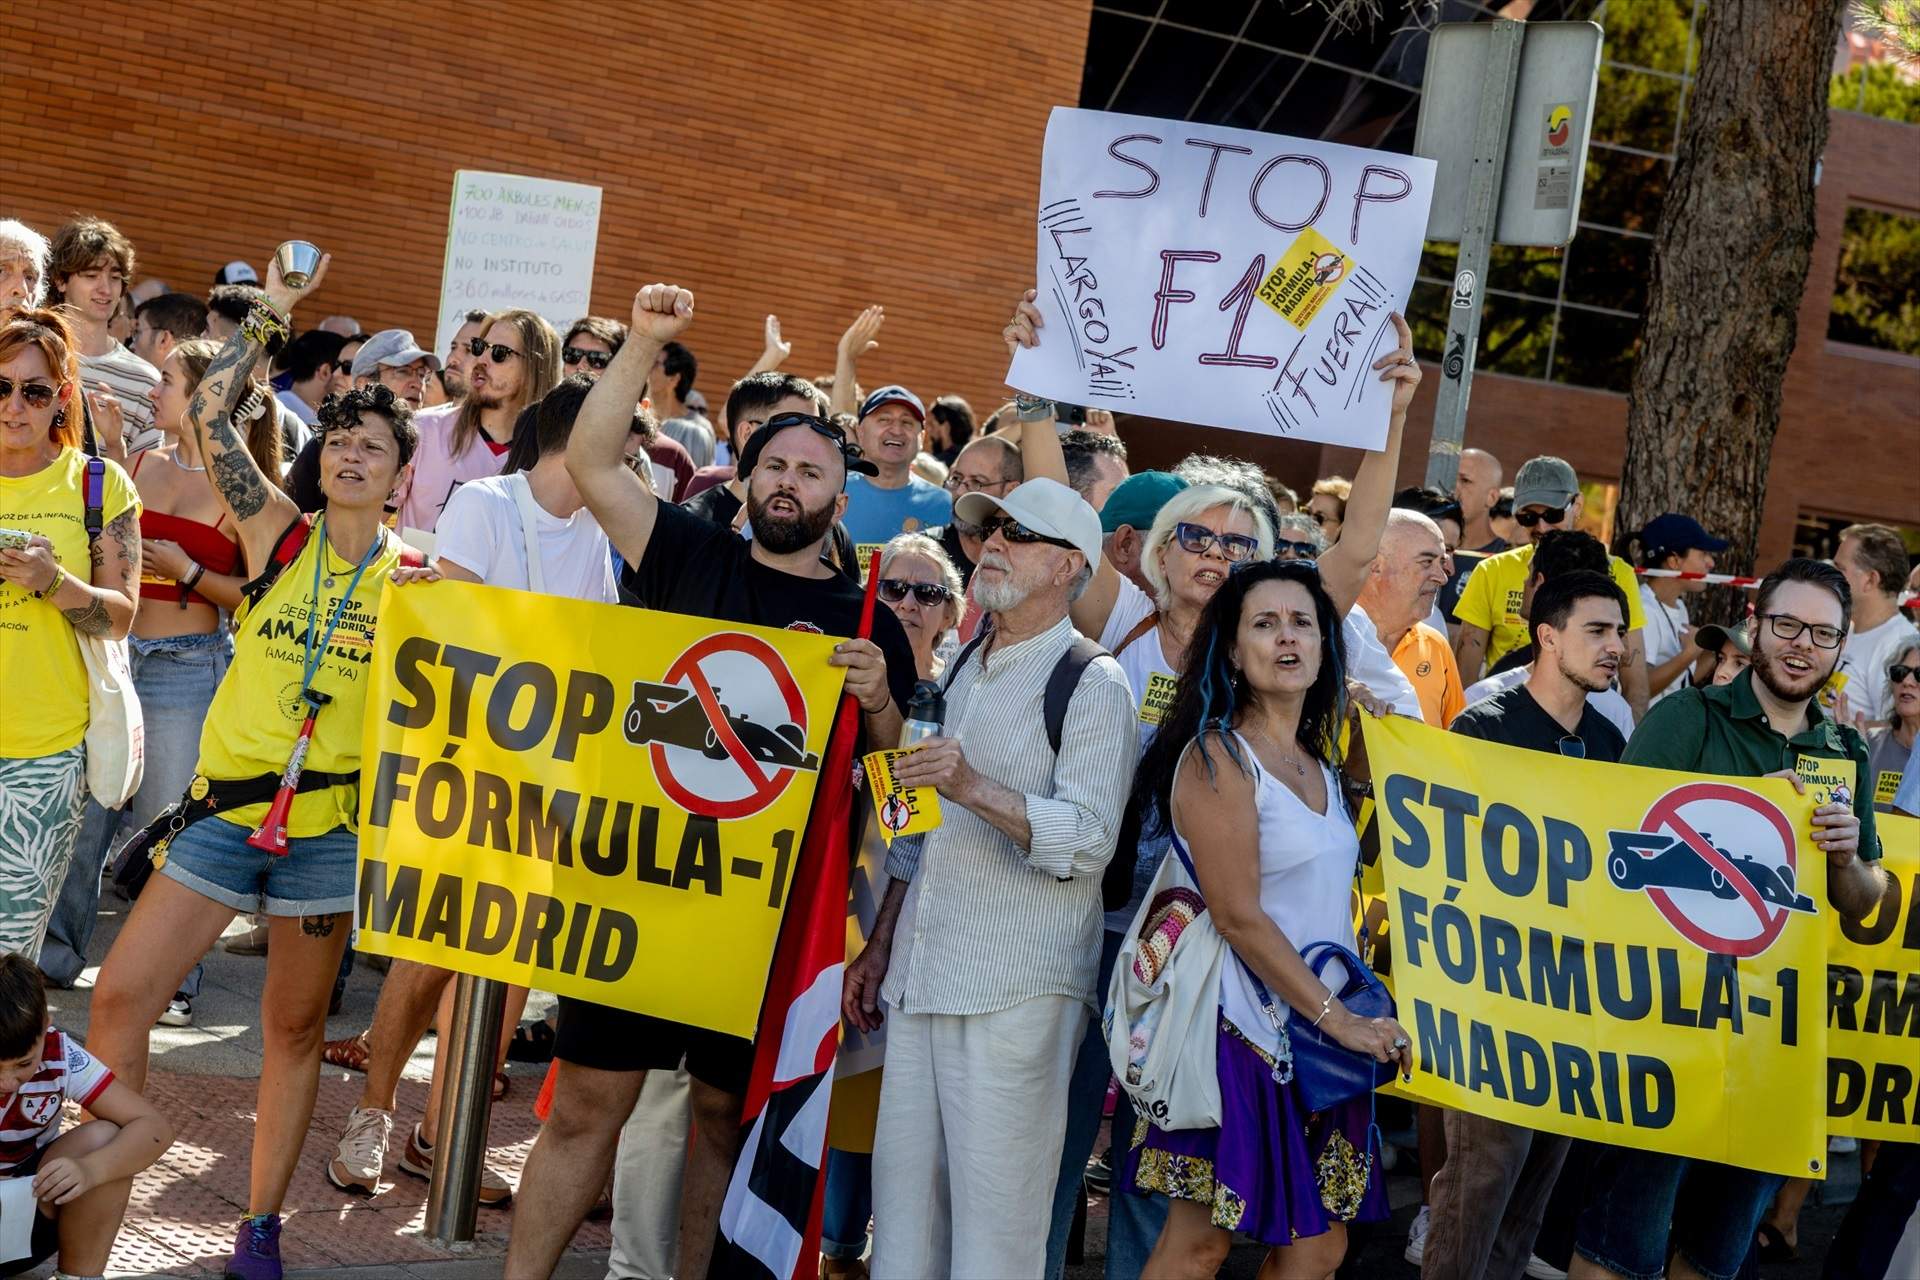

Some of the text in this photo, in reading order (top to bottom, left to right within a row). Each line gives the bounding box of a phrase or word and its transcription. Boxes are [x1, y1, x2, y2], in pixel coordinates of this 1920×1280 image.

[1093, 134, 1412, 244] STOP
[454, 255, 563, 279] NO INSTITUTO
[455, 227, 478, 246] NO
[1152, 250, 1278, 368] F1
[1260, 267, 1287, 300] STOP
[1271, 251, 1320, 309] FÓRMULA-1
[1281, 277, 1315, 317] MADRID
[858, 545, 879, 553] STO
[303, 594, 318, 608] LA
[387, 636, 615, 762] STOP
[1798, 758, 1819, 772] STOP
[369, 744, 795, 909] FÓRMULA-1
[1384, 774, 1593, 907] STOP
[358, 858, 639, 983] MADRID
[1399, 886, 1798, 1047] FÓRMULA-1
[1414, 998, 1676, 1130] MADRID
